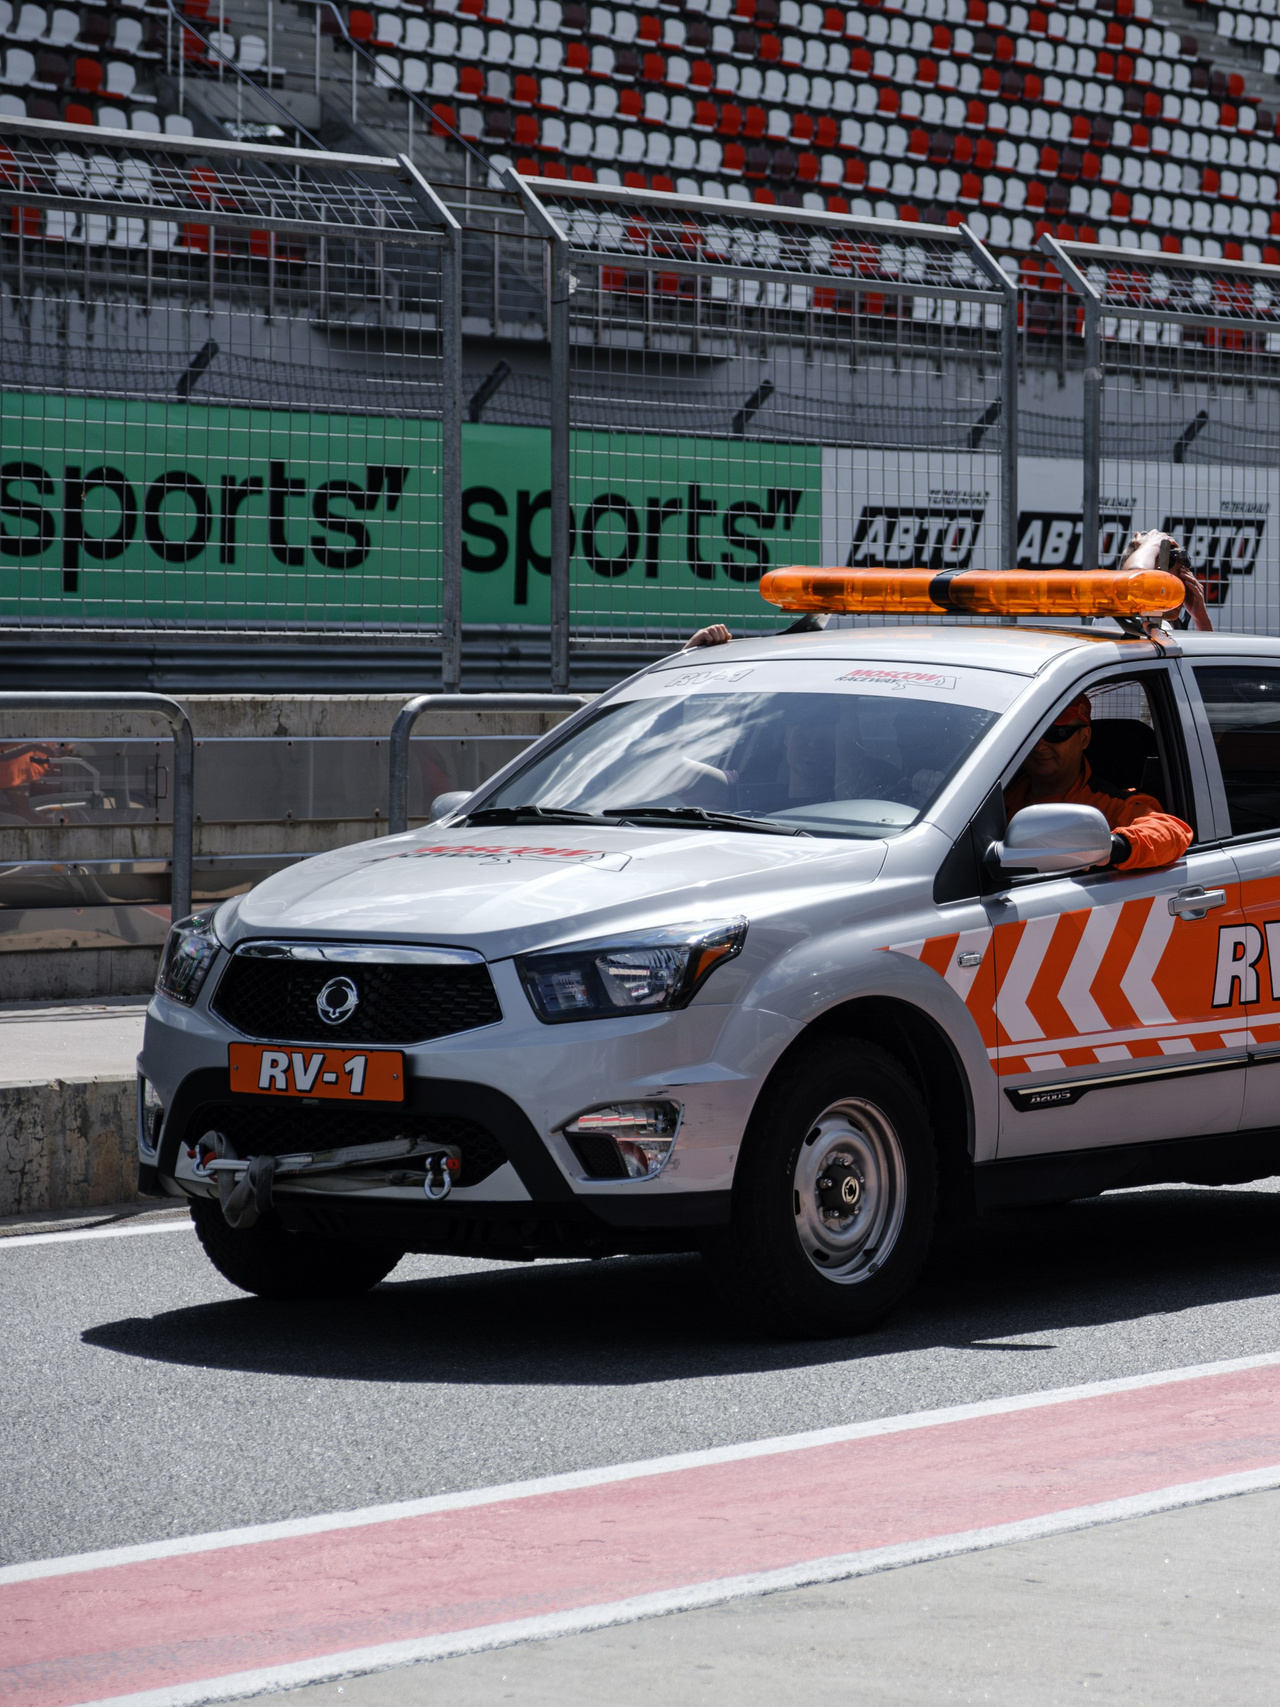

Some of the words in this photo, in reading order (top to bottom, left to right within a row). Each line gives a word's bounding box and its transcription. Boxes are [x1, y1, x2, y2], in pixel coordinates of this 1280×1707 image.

[854, 513, 974, 563] АВТО
[664, 668, 755, 688] RV-1
[845, 669, 945, 682] MOSCOW
[258, 1050, 368, 1096] RV-1
